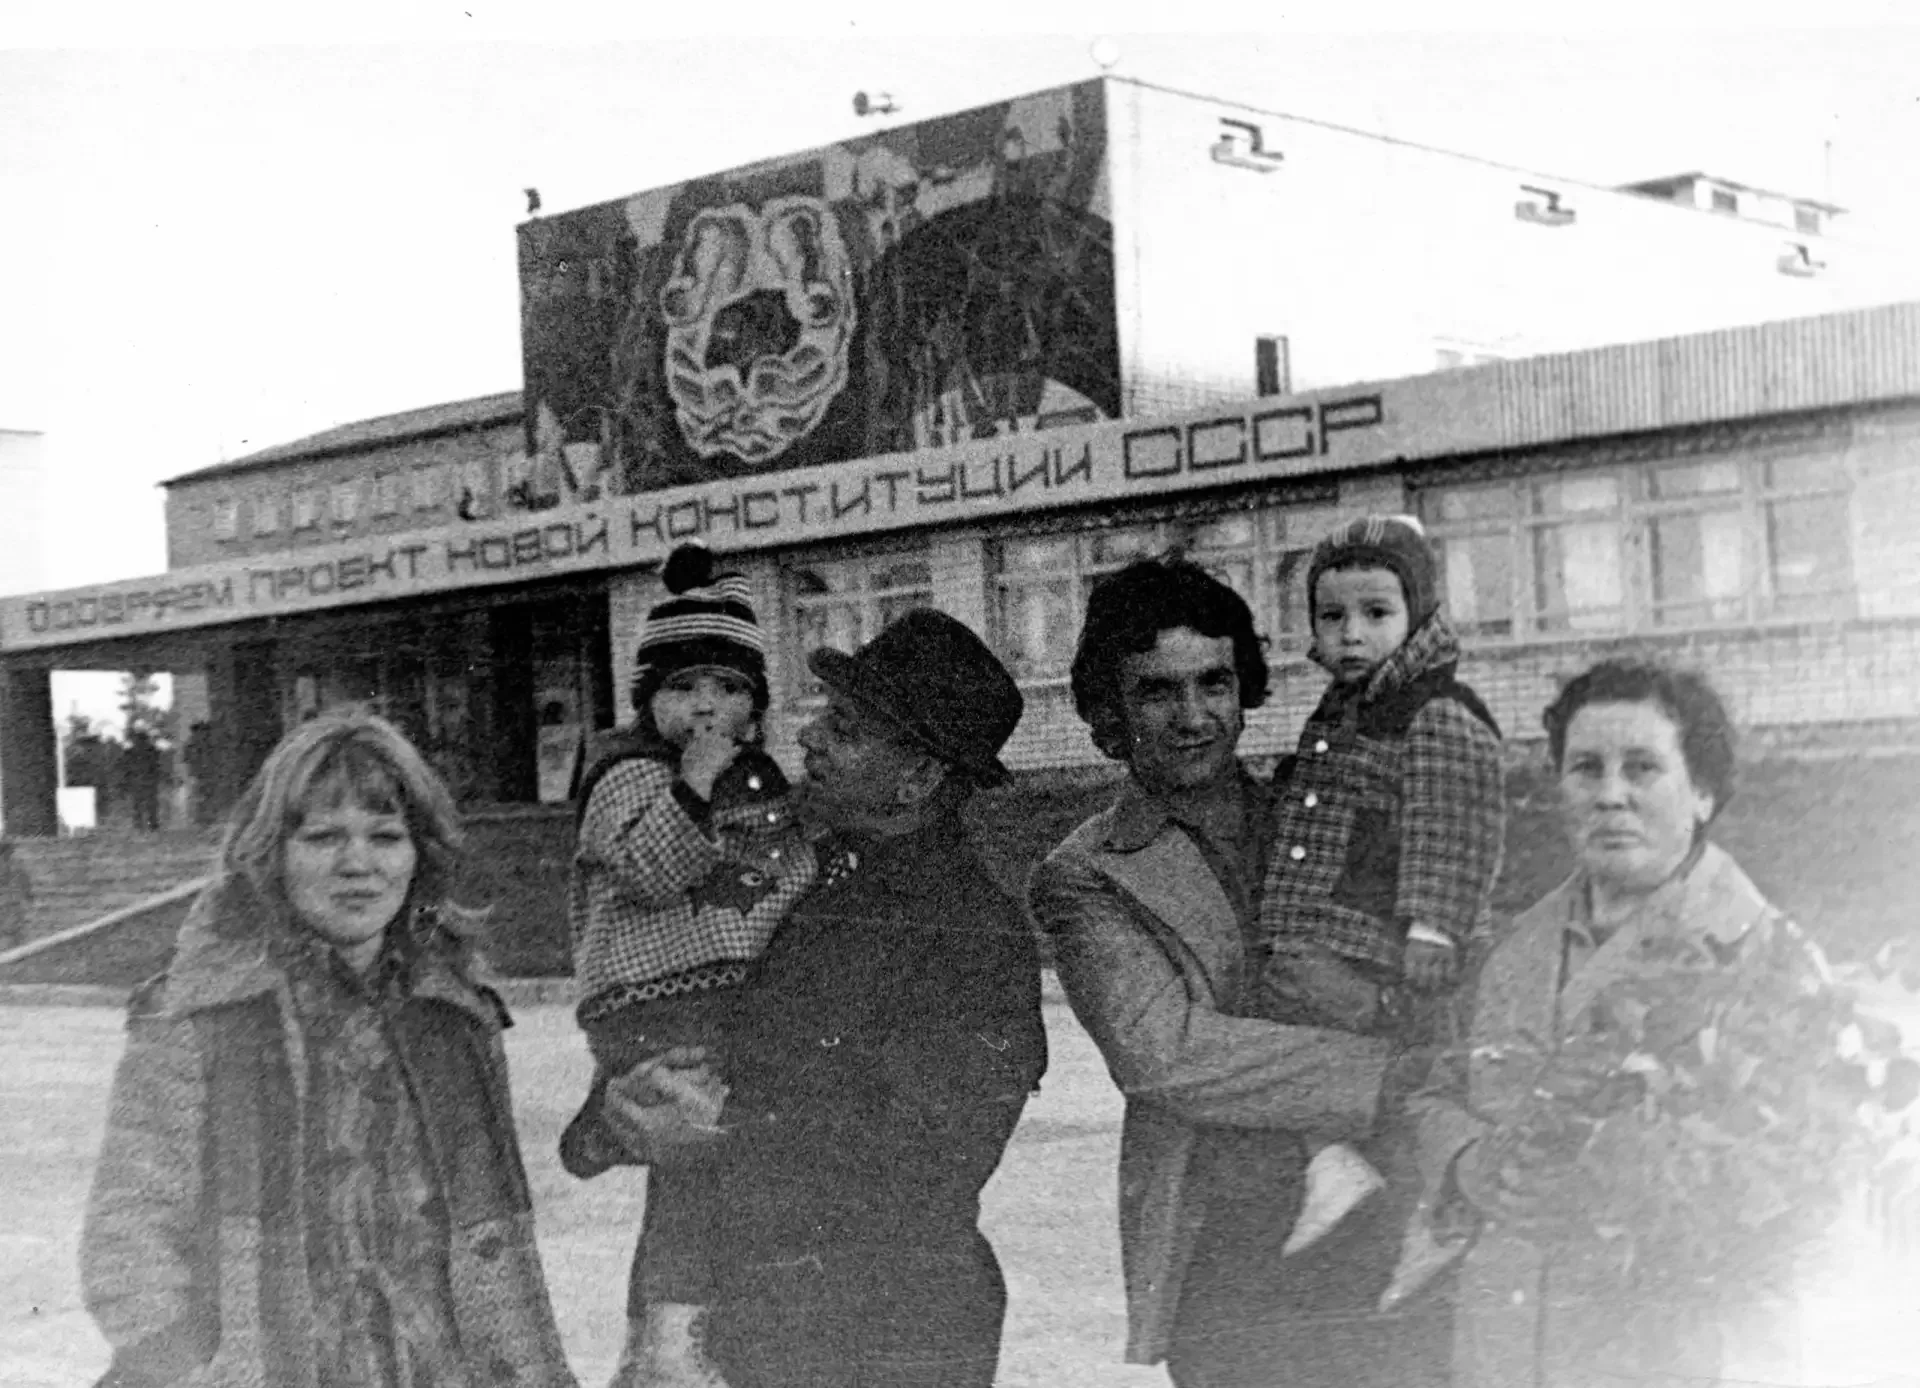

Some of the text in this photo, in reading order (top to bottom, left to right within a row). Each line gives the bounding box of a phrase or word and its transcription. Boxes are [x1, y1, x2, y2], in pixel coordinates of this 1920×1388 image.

[250, 543, 428, 604] ПРОЕКТ
[447, 512, 608, 572] НОВОЙ
[631, 442, 1093, 546] КОНСТИТУЦИИ
[1123, 394, 1383, 479] СССР
